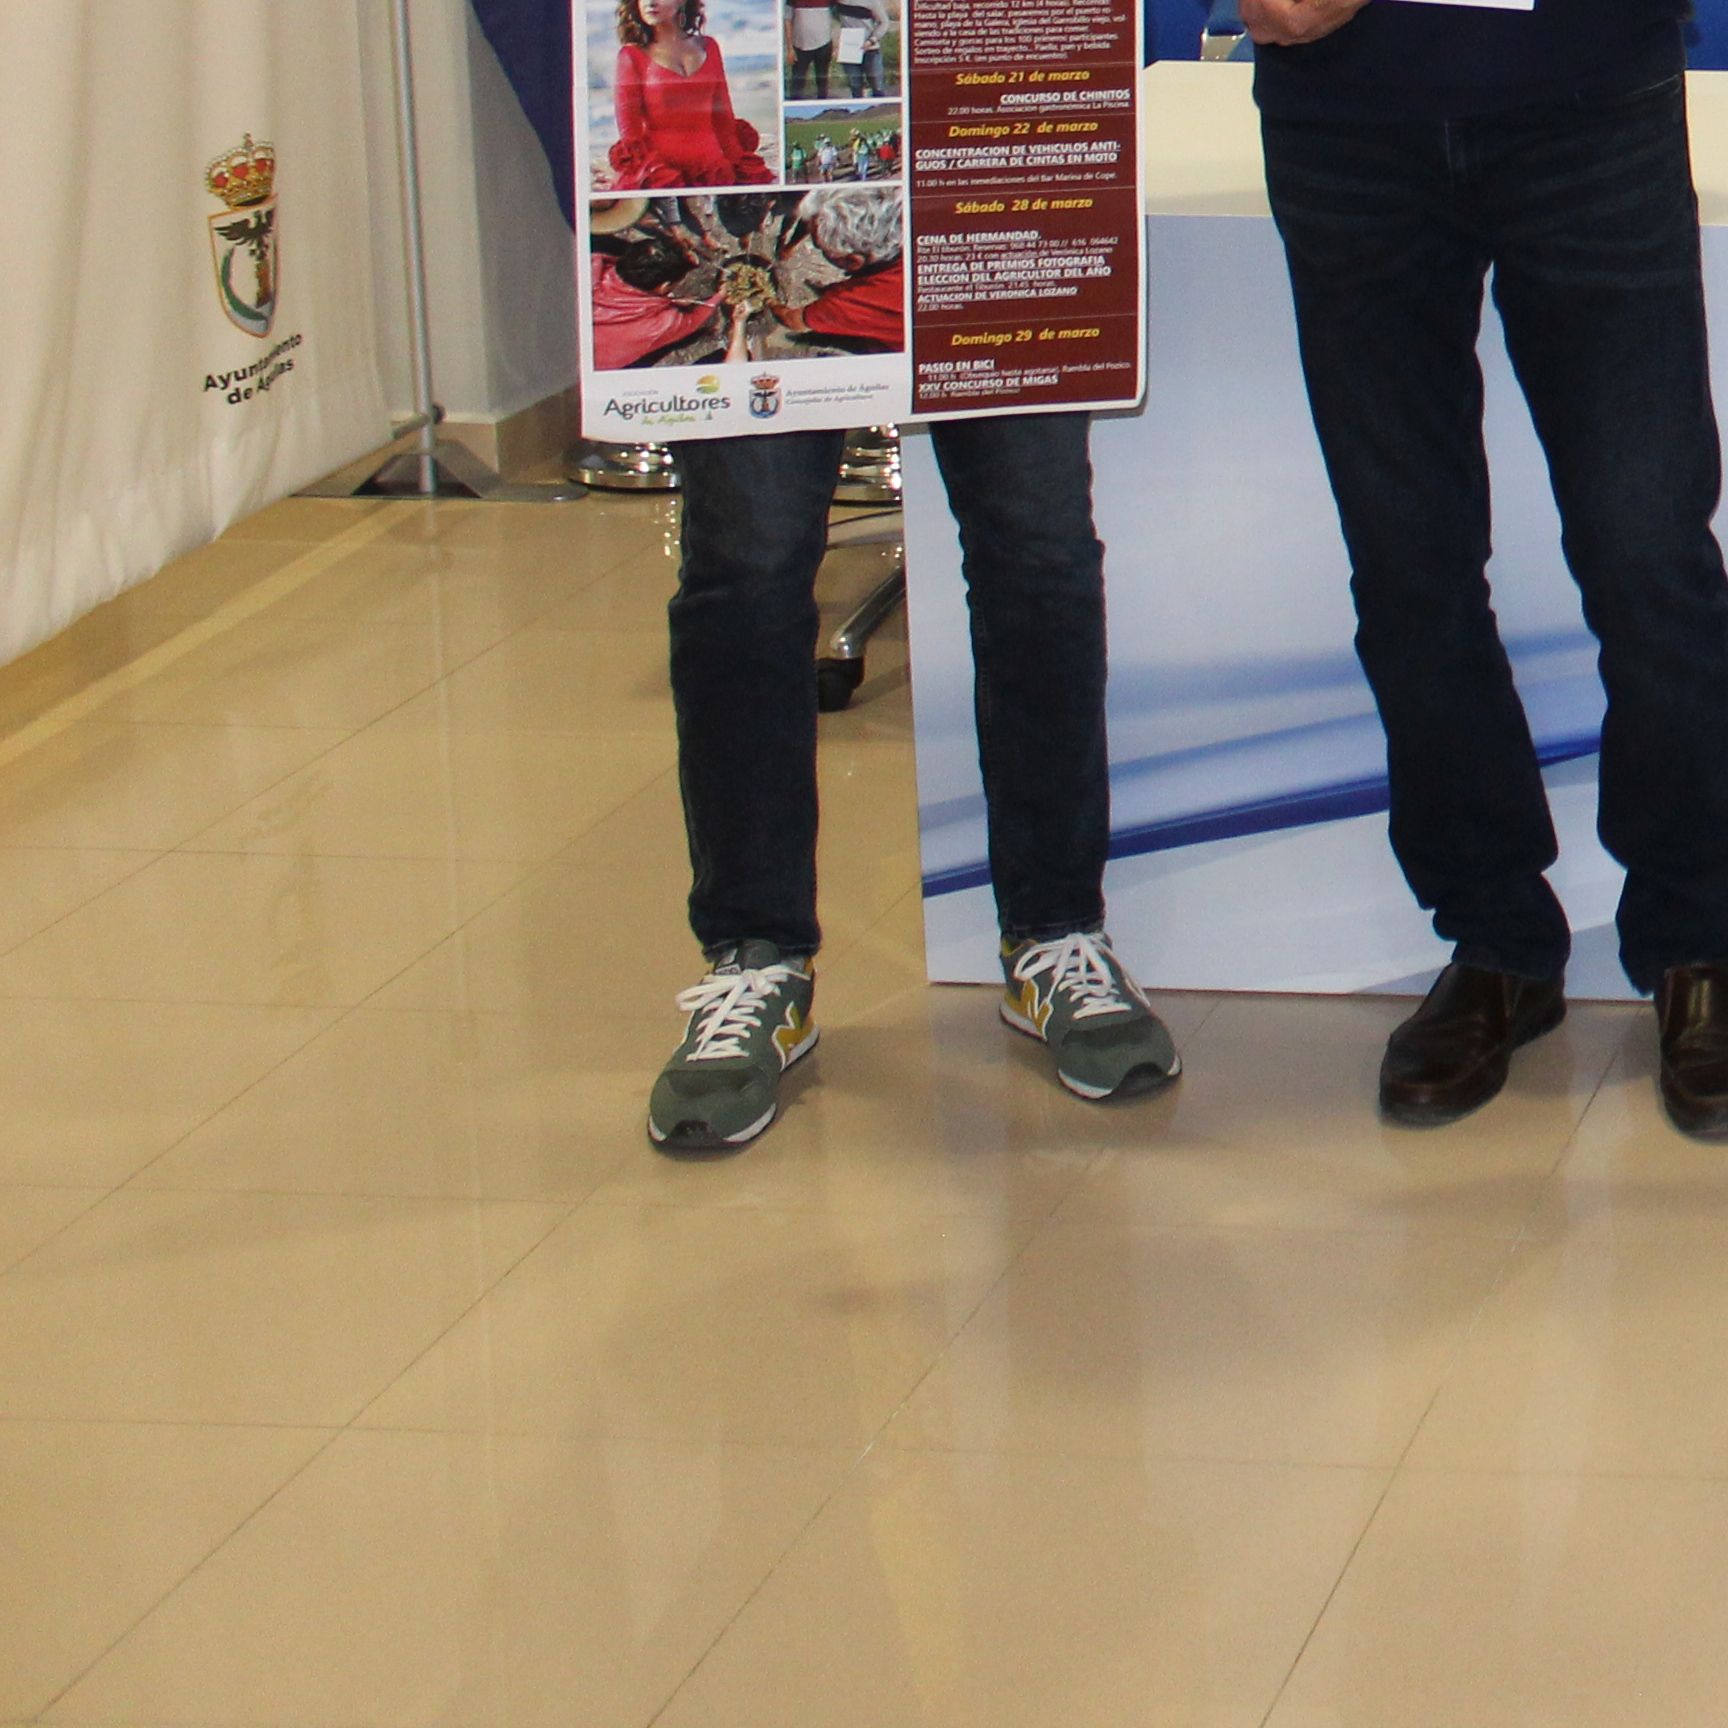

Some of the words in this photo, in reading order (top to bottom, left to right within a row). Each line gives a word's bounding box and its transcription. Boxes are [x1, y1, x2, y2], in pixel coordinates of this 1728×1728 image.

[956, 73, 1005, 85] Sábado
[1009, 72, 1023, 83] 21
[1029, 71, 1045, 82] de
[1048, 71, 1090, 81] marzo
[1001, 93, 1061, 104] CONCURSO
[1064, 91, 1077, 101] DE
[1079, 89, 1130, 100] CHINITOS
[949, 125, 1010, 138] Domingo
[1013, 124, 1030, 135] 22
[1037, 122, 1052, 133] de
[1056, 122, 1098, 132] marzo
[1012, 145, 1026, 155] DE
[1029, 142, 1088, 153] VEHICULOS
[915, 161, 946, 170] GUOS
[957, 158, 1007, 168] CARRERA
[1010, 157, 1024, 166] DE
[1026, 155, 1065, 165] CINTAS
[1067, 154, 1082, 163] EN
[1085, 153, 1117, 162] MOTO
[956, 201, 1004, 214] Sábado
[1012, 200, 1028, 211] 28
[1032, 200, 1048, 210] de
[1051, 199, 1093, 209] marzo
[917, 235, 946, 245] CENA
[950, 234, 964, 244] DE
[918, 263, 968, 274] ENTREGA
[970, 262, 984, 272] DE
[987, 259, 1035, 271] PREMIOS
[972, 273, 991, 282] DEL
[994, 269, 1061, 281] AGRICULTOR
[1064, 267, 1083, 278] DEL
[975, 291, 987, 301] DE
[1038, 287, 1077, 297] LOZANO
[952, 334, 1012, 347] Domingo
[1015, 331, 1032, 342] 29
[1039, 329, 1055, 340] de
[1058, 328, 1100, 338] marzo
[919, 362, 953, 373] PASEO
[956, 360, 971, 370] EN
[973, 359, 995, 369] BICI
[919, 381, 941, 392] XXV
[943, 378, 1004, 390] CONCURSO
[1006, 377, 1020, 386] DE
[1022, 375, 1058, 385] MIGAS
[227, 387, 253, 404] de
[604, 395, 730, 420] Agricultores
